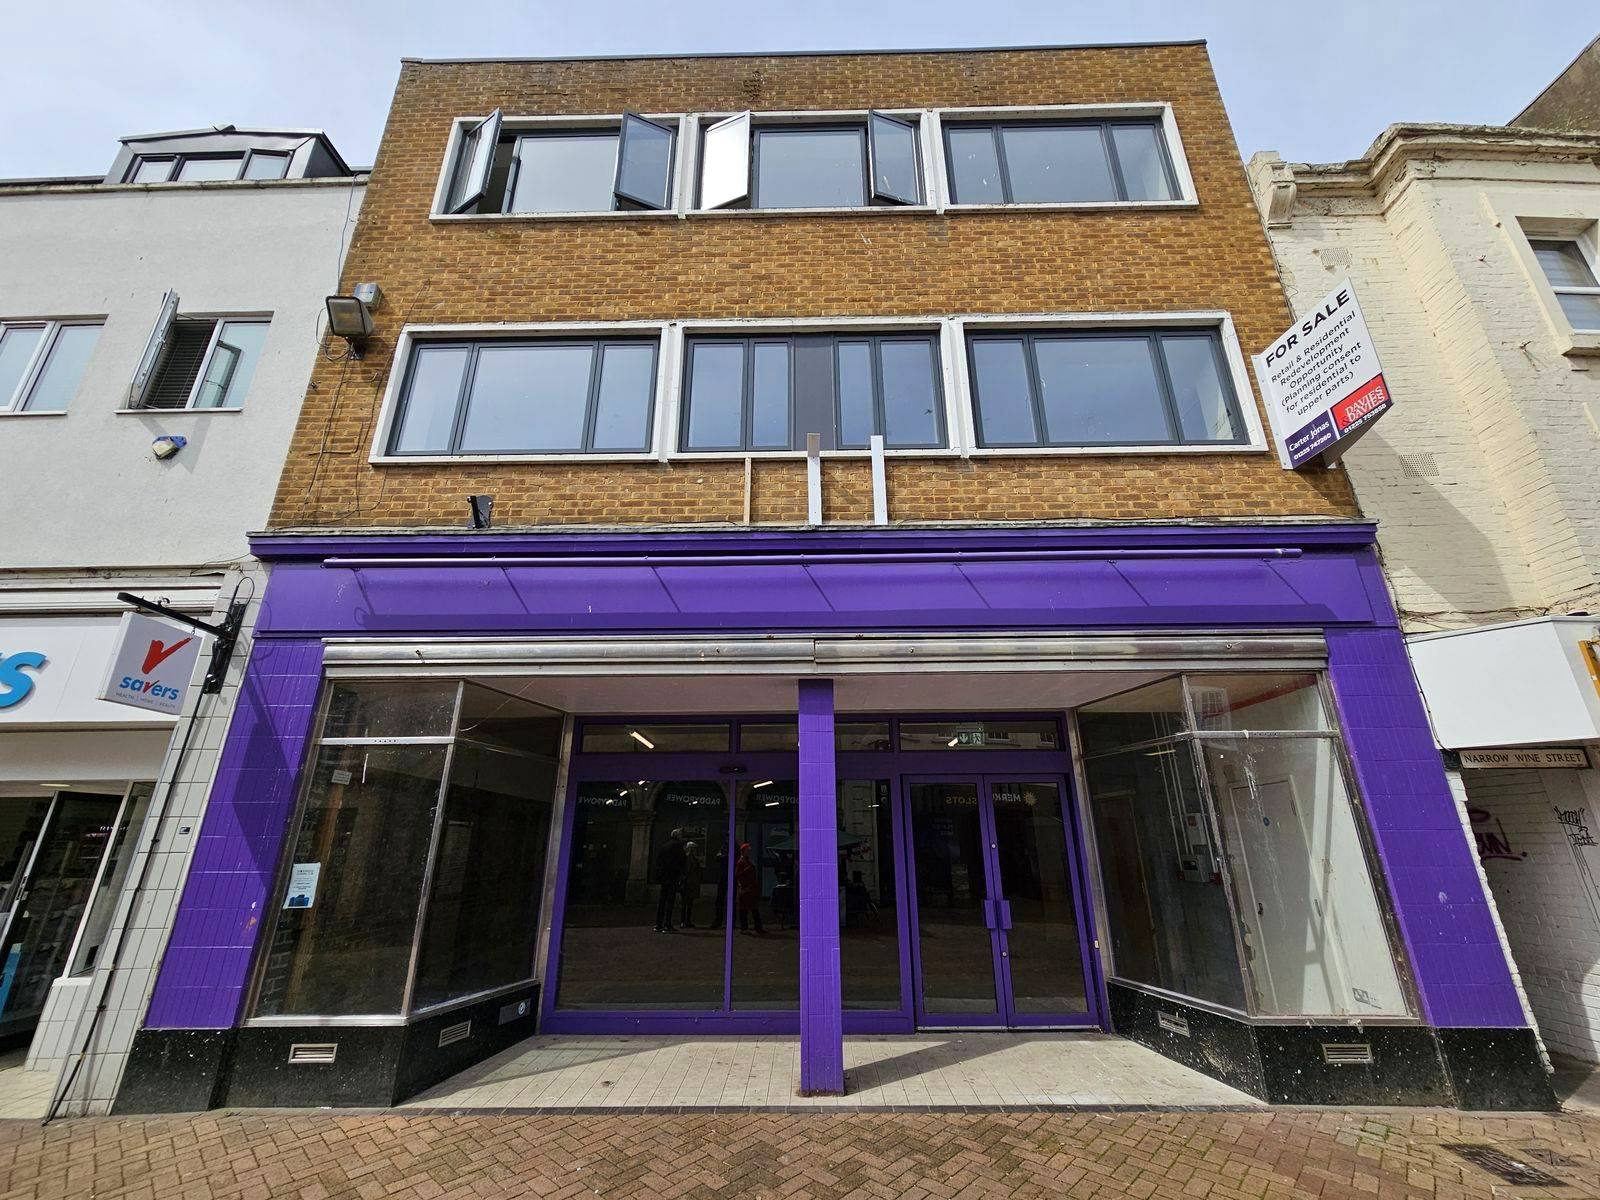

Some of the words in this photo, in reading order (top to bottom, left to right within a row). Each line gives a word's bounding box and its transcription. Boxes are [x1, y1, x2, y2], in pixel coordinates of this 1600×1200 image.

[1265, 334, 1299, 368] FOR
[1302, 288, 1350, 337] SALE
[1271, 360, 1295, 383] Retail
[1295, 354, 1302, 363] &
[1303, 310, 1356, 356] Residential
[1280, 327, 1350, 386] Redevelopment
[1281, 373, 1321, 407] (Planning
[1323, 341, 1362, 374] consent
[1289, 344, 1344, 389] Opportunity
[1286, 400, 1299, 413] for
[1300, 363, 1348, 403] residential
[1350, 354, 1361, 365] to
[1297, 393, 1323, 416] upper
[1325, 371, 1354, 397] parts)
[1344, 385, 1383, 414] DAVIES
[1347, 393, 1385, 423] DAVIES
[1289, 434, 1310, 451] Carter
[1310, 421, 1330, 439] Jonas
[119, 676, 180, 701] savers
[1463, 753, 1509, 764] NARROW
[1514, 753, 1541, 763] WINE
[1545, 752, 1582, 763] STREET
